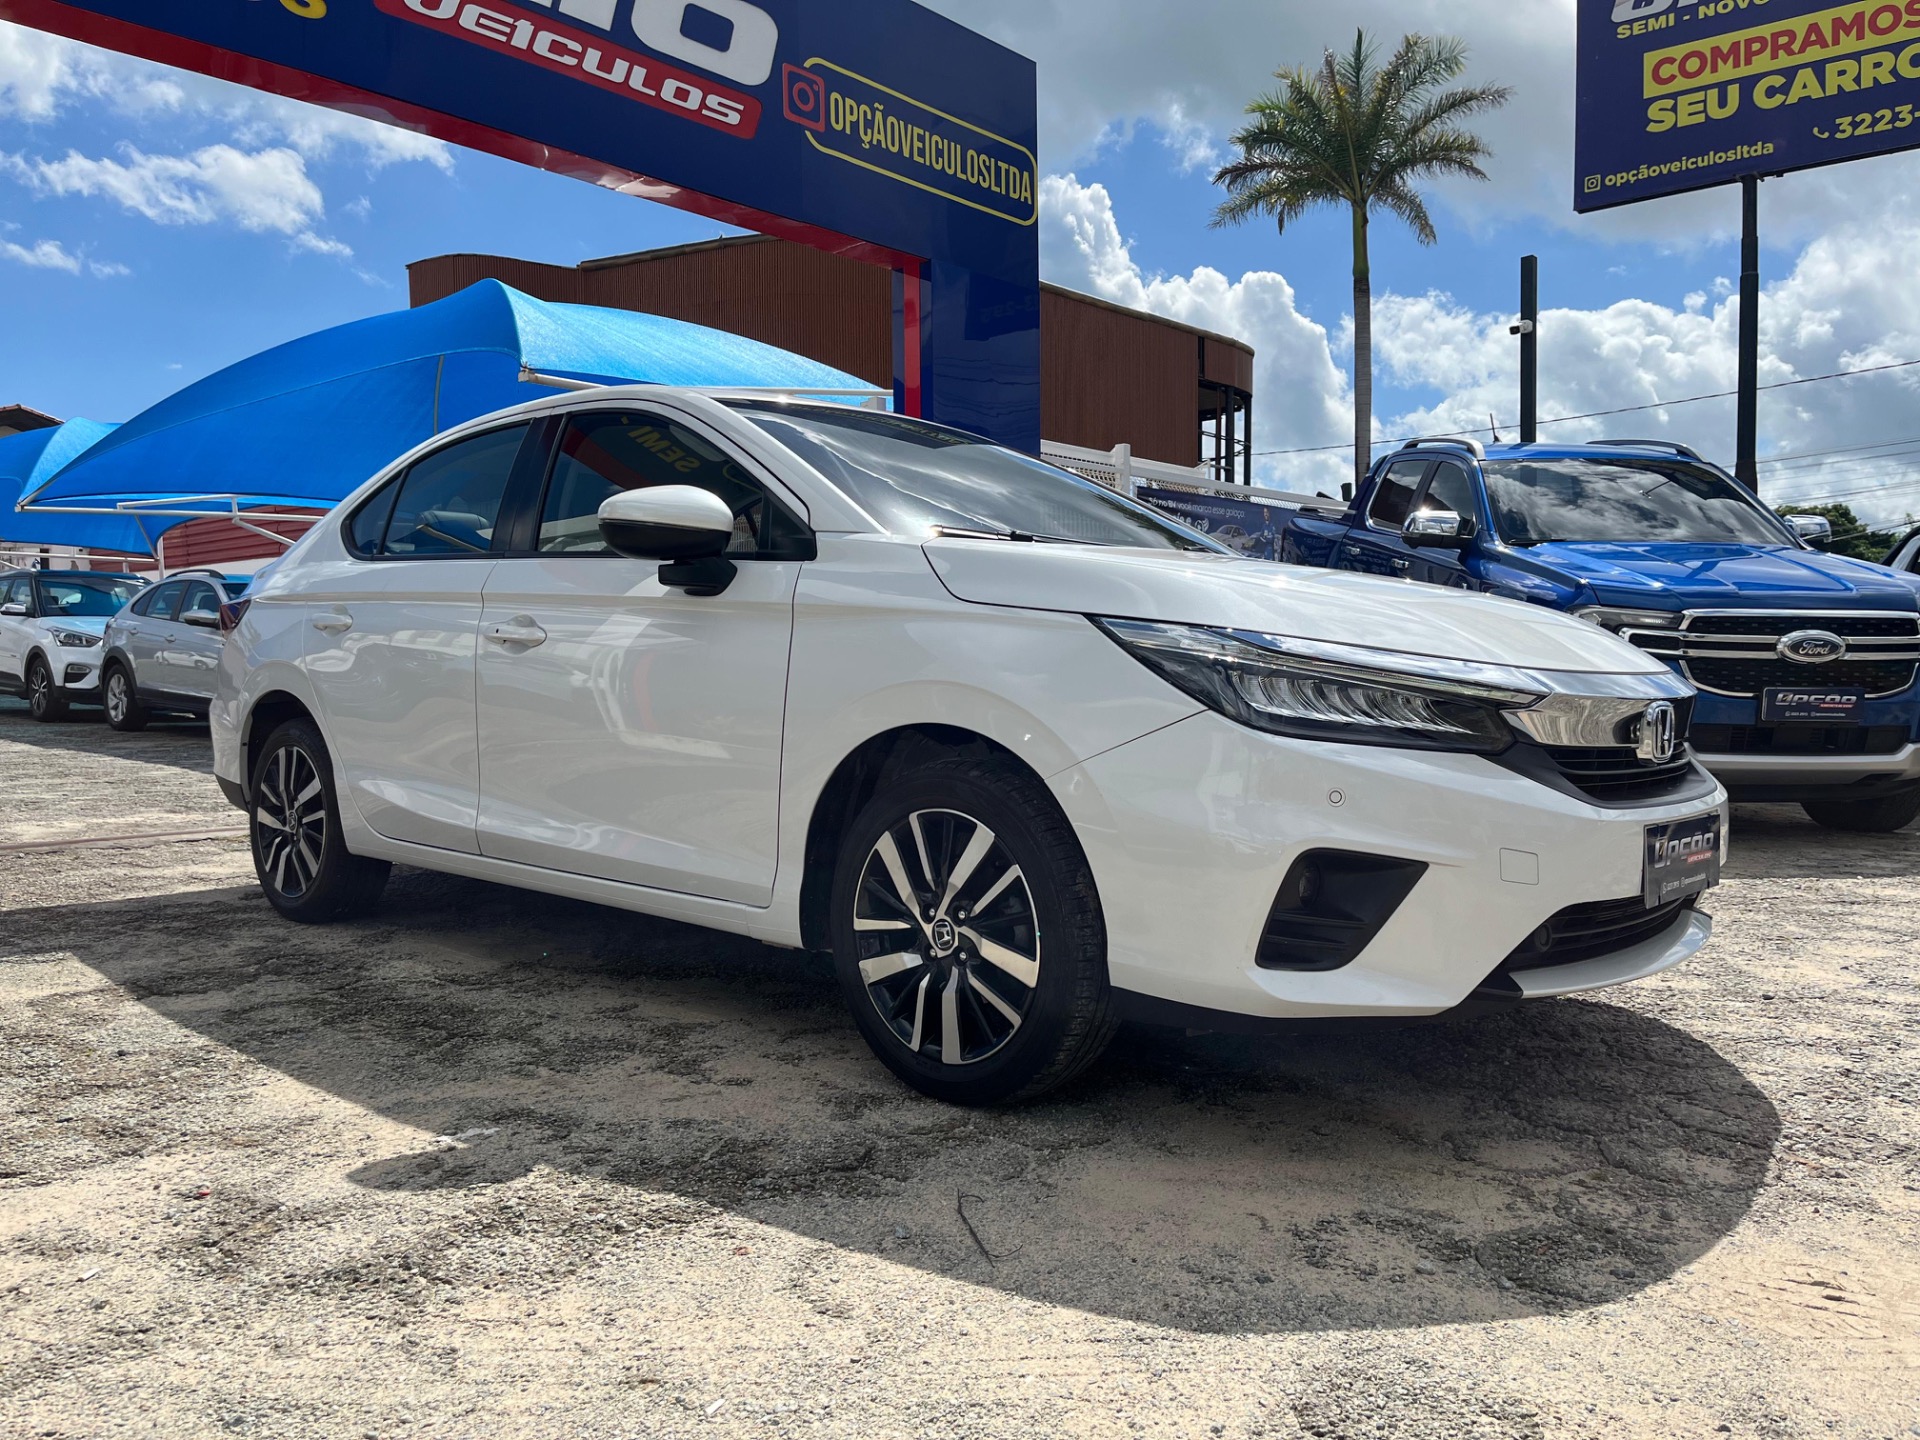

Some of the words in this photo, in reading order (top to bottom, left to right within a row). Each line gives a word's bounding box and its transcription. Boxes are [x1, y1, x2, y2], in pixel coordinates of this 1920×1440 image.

[1616, 13, 1675, 39] SEMI
[1645, 83, 1740, 132] SEU
[829, 91, 1032, 204] OPÇÃOVEICULOSLTDA
[1604, 141, 1774, 187] opçãoveiculosltda
[1193, 504, 1212, 513] marca
[1212, 507, 1225, 515] esse
[1798, 640, 1831, 655] Ford
